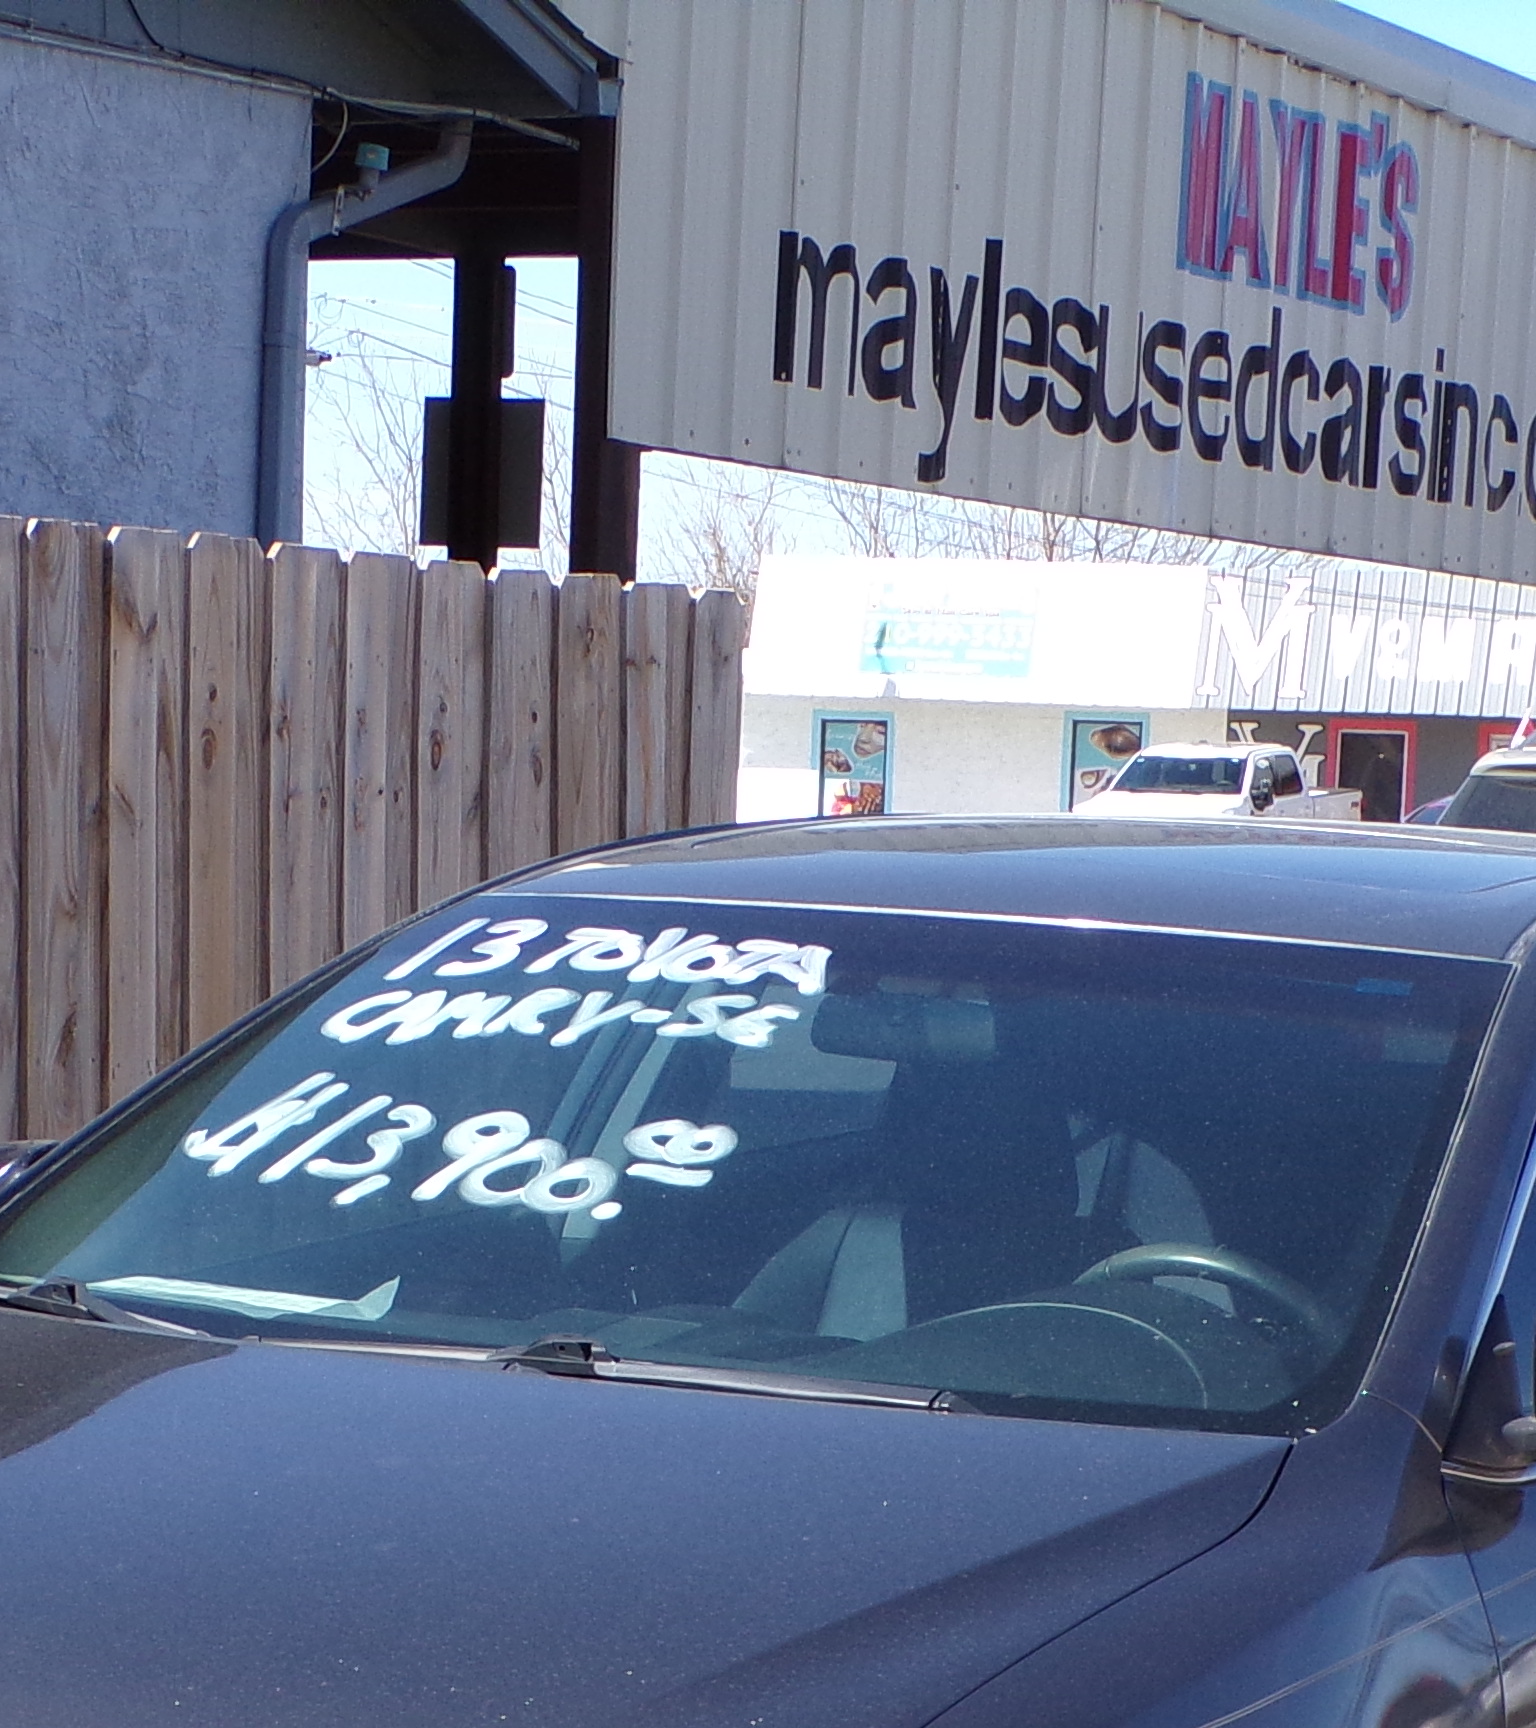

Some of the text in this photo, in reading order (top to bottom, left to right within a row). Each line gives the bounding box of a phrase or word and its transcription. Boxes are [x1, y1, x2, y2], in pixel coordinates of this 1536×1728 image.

[1176, 71, 1420, 323] MAYLE'S
[384, 917, 834, 996] 13 TOYOTA
